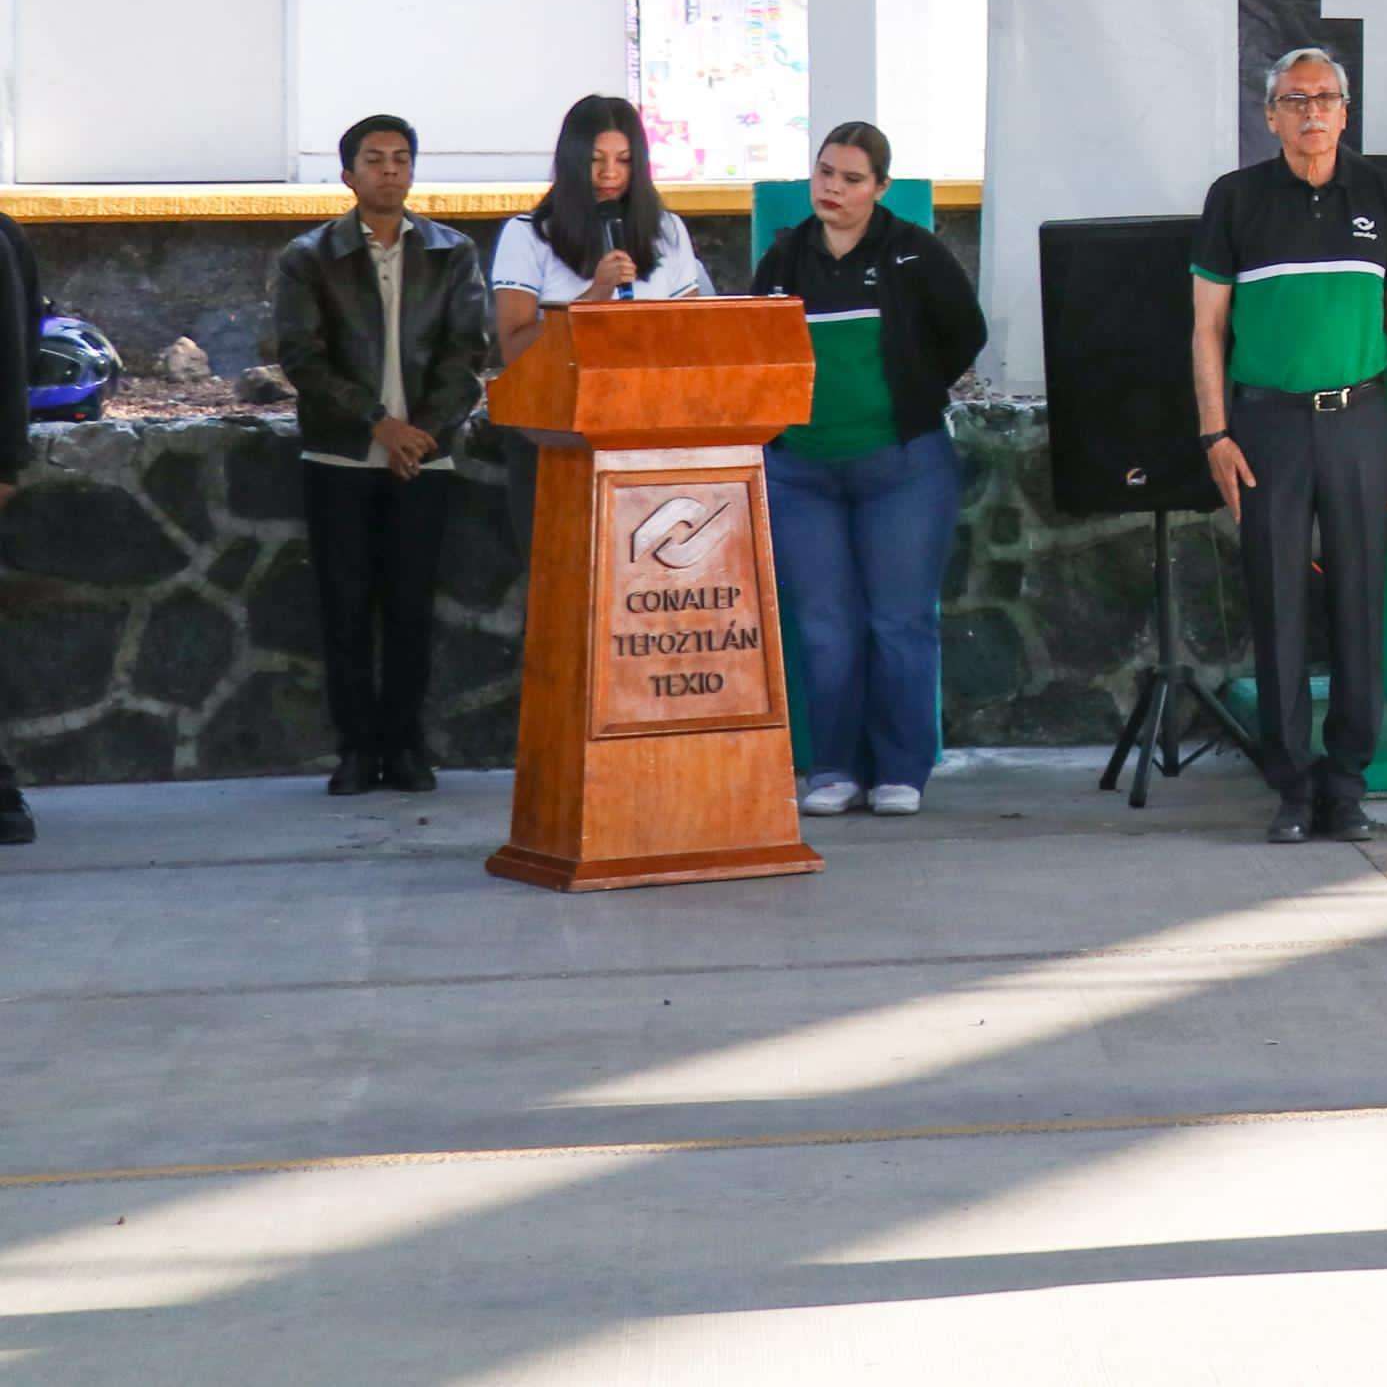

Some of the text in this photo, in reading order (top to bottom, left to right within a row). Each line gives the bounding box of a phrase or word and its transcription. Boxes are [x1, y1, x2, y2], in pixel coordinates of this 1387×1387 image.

[625, 586, 741, 614] CONALEP
[612, 619, 758, 657] TEPOZTLÁN
[649, 672, 724, 698] TEXIO
